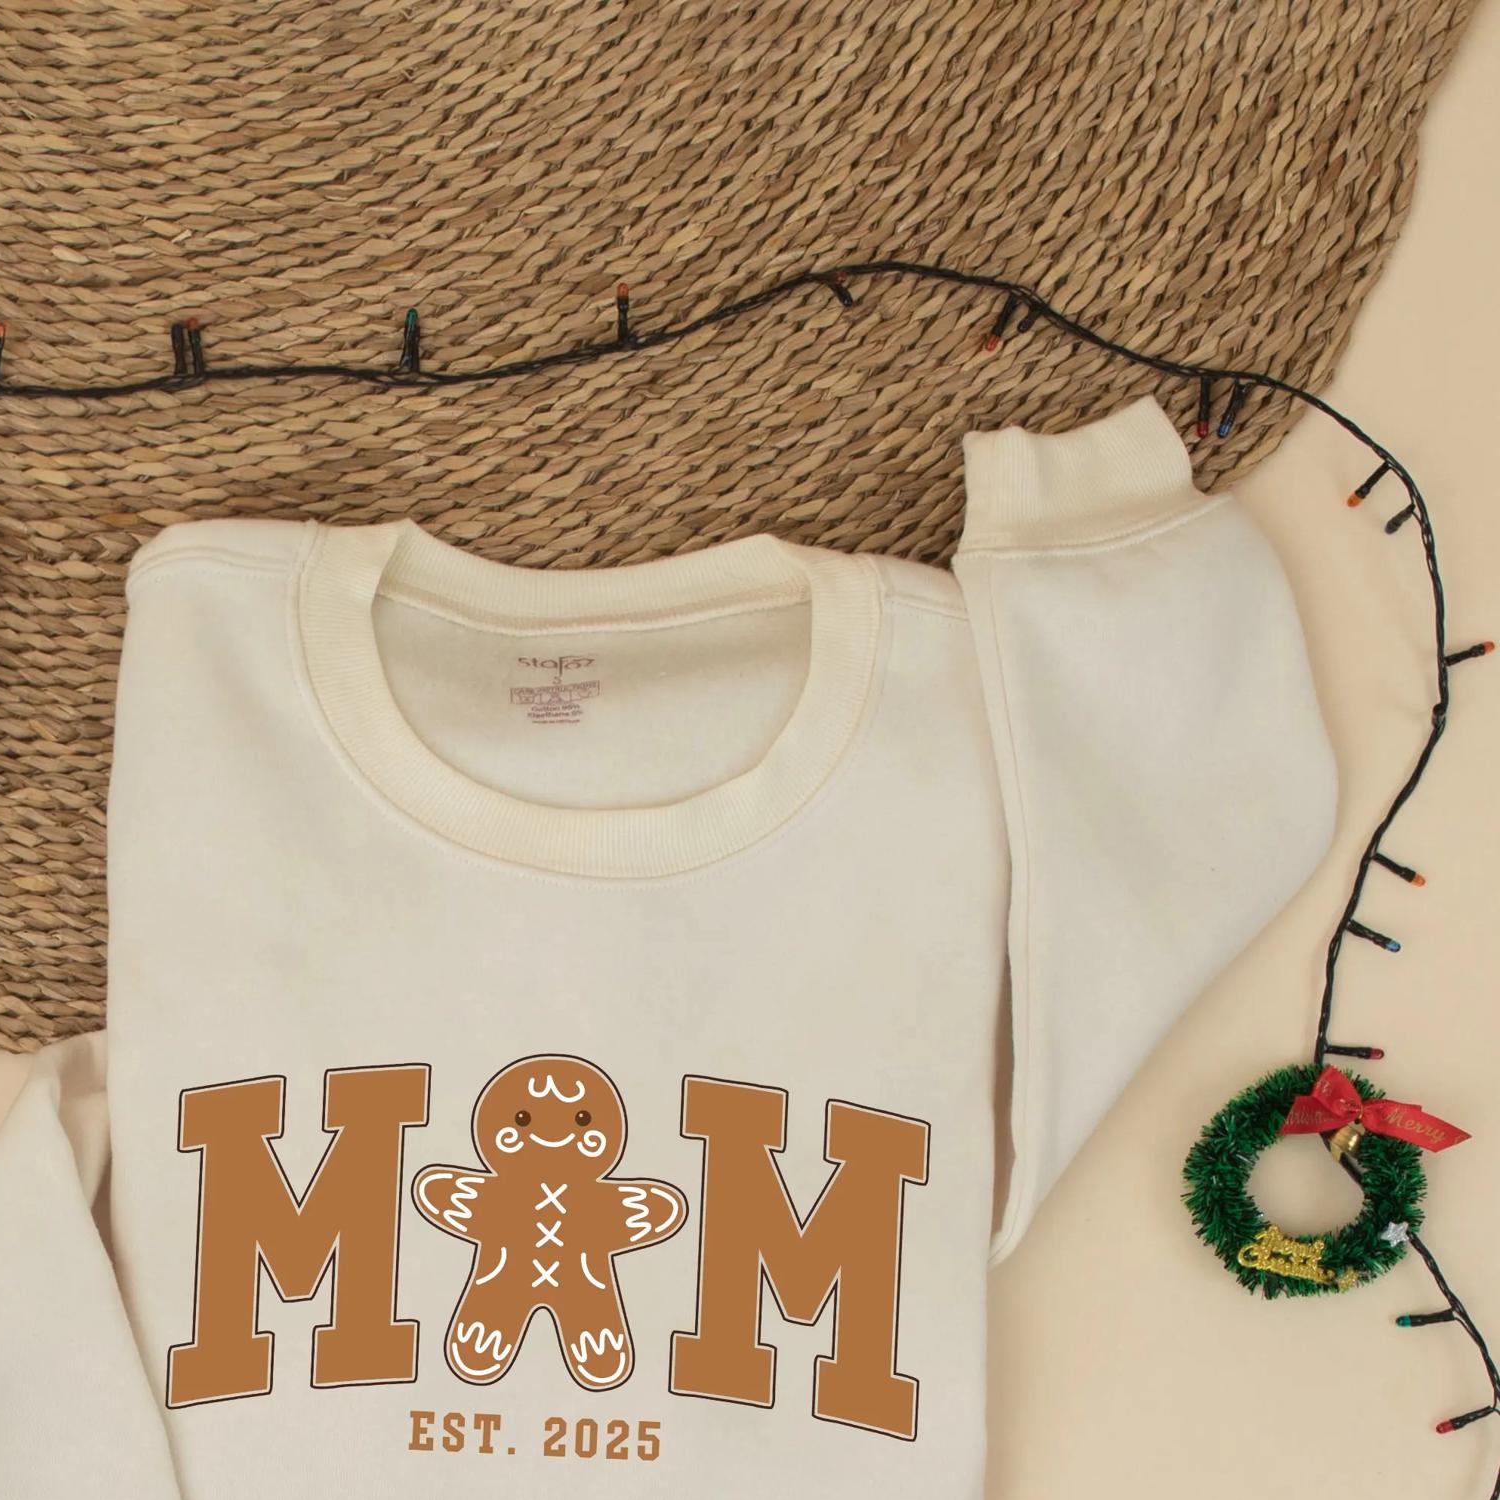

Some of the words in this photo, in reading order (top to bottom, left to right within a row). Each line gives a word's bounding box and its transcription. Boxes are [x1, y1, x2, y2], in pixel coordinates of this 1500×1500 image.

[1385, 1108, 1447, 1144] Merry
[408, 1410, 517, 1456] EST.
[543, 1417, 663, 1462] 2025
